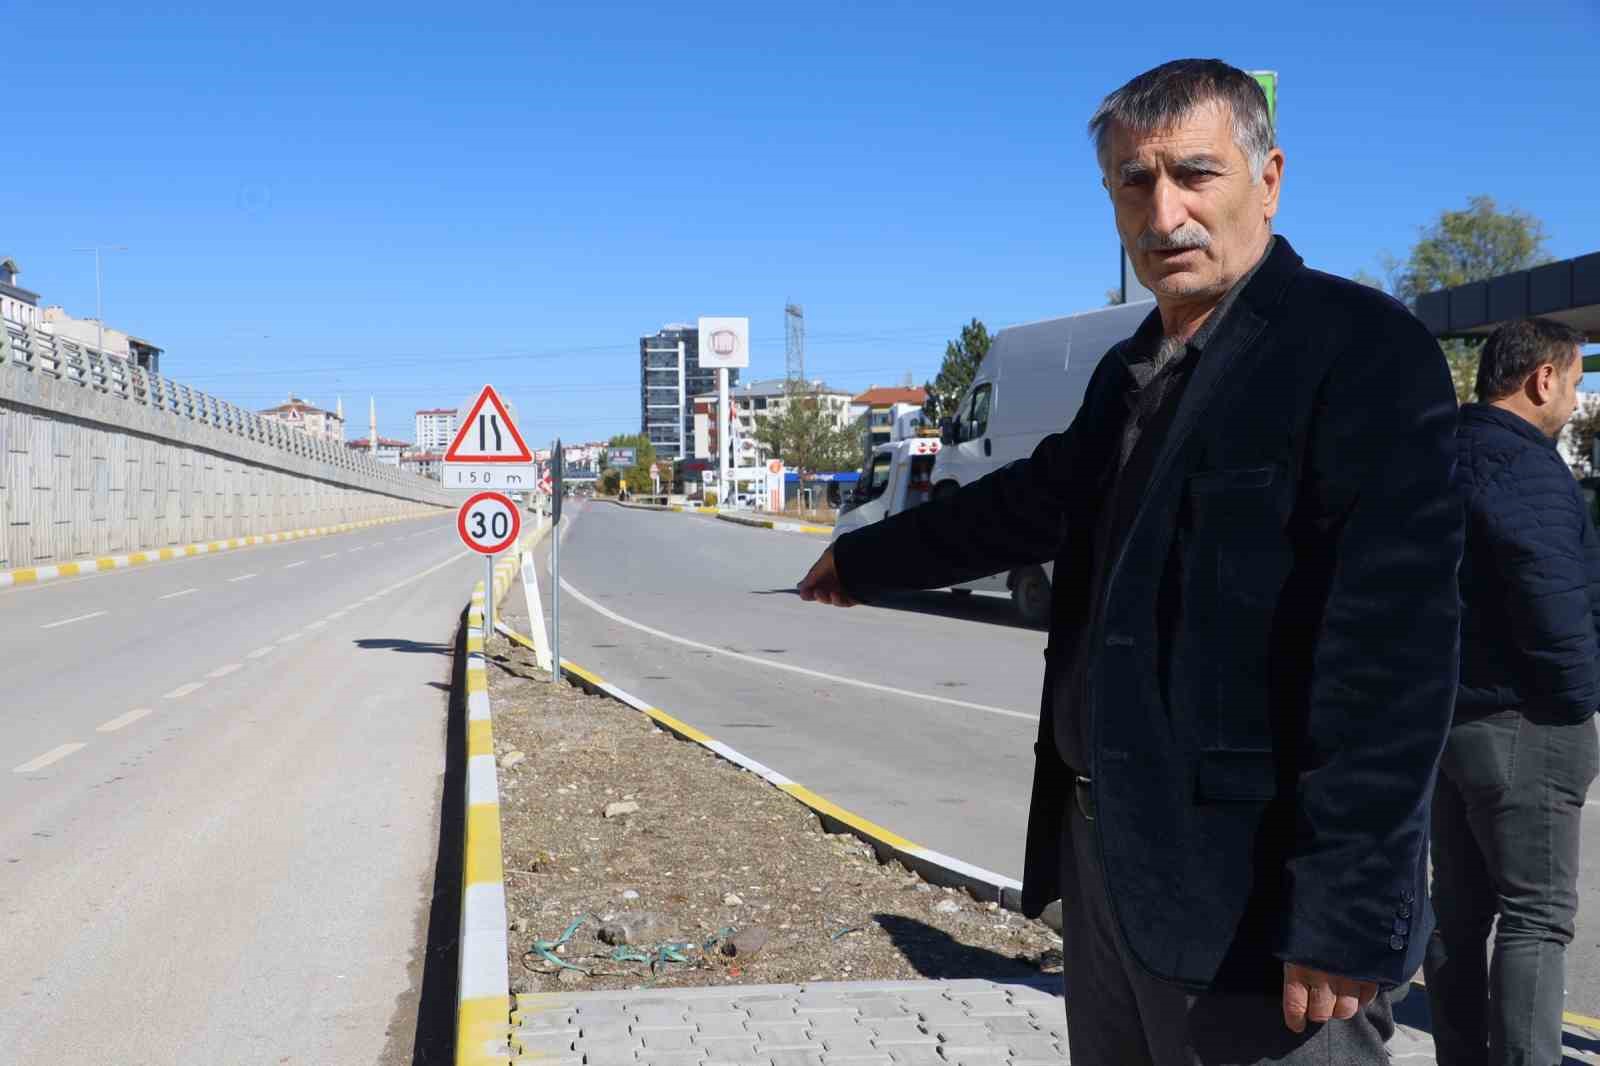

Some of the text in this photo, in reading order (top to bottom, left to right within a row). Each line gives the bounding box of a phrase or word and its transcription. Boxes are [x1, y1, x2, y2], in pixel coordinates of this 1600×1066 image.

[458, 471, 522, 484] 150 m
[471, 511, 508, 539] 30
